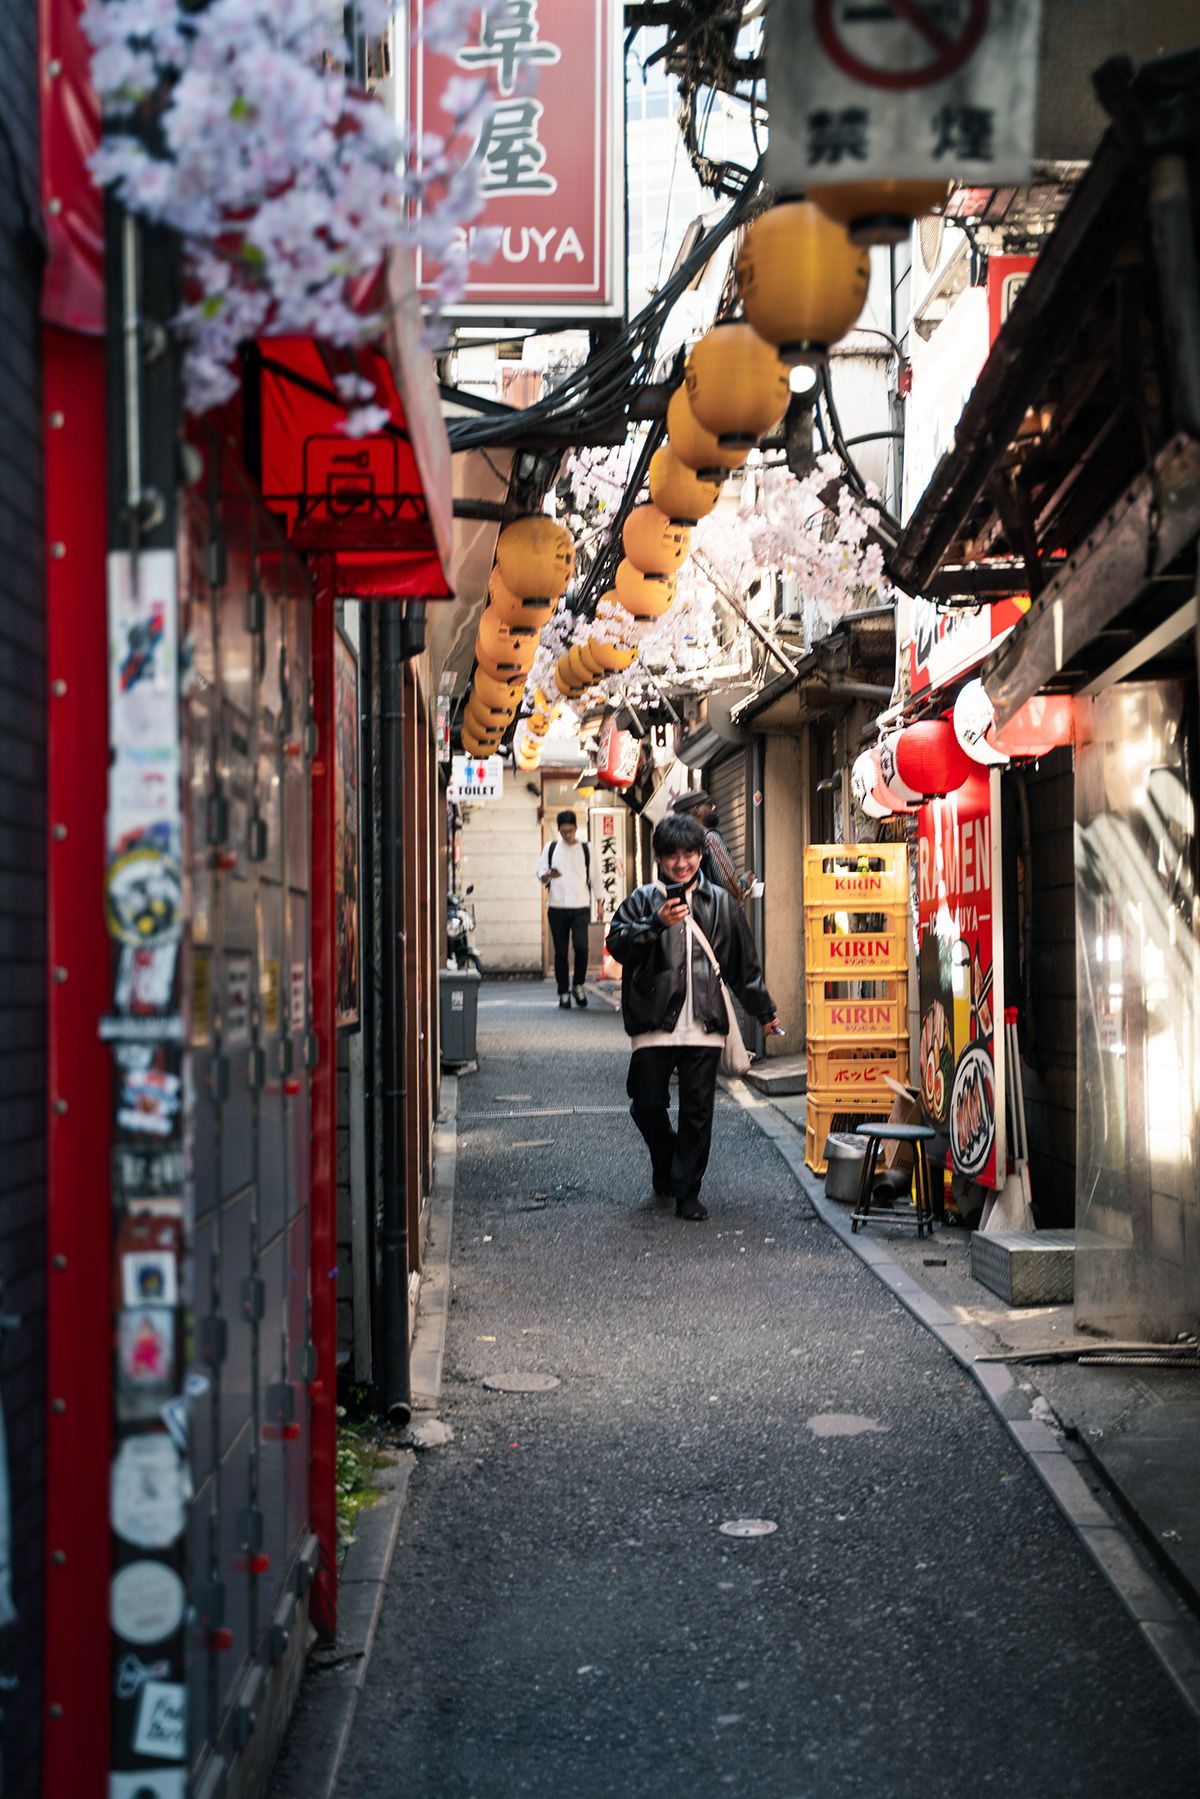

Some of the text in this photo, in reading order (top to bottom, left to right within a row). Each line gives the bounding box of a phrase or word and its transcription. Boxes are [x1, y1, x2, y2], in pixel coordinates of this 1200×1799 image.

[457, 785, 496, 796] TOILET
[919, 815, 991, 902] RAMEN
[834, 877, 882, 891] KIRIN
[829, 940, 890, 957] KIRIN
[830, 1007, 891, 1025] KIRIN
